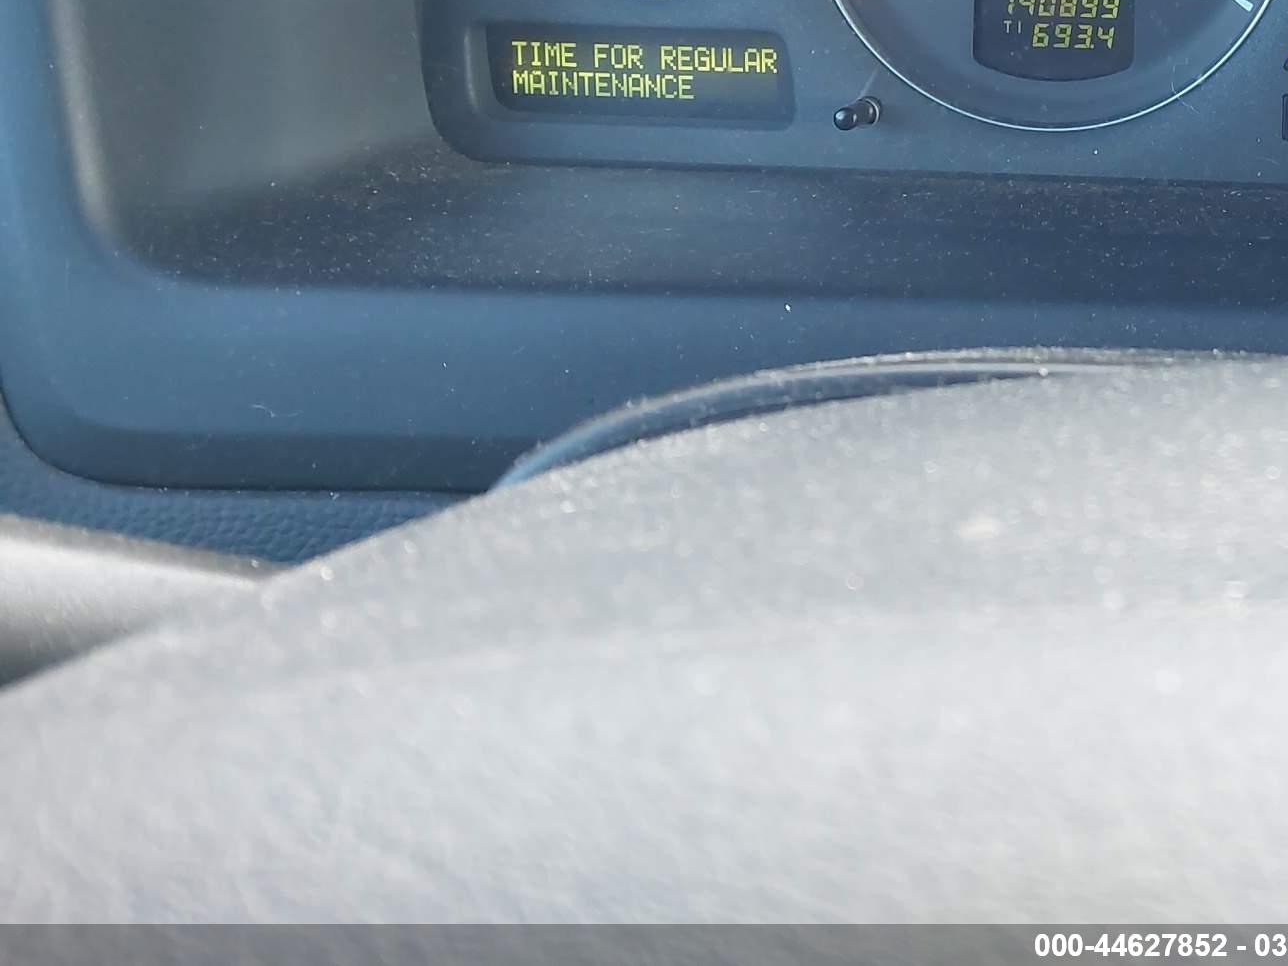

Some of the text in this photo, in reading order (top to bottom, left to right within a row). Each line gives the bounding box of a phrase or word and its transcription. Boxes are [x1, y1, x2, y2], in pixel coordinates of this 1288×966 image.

[1032, 23, 1115, 50] 693.4
[512, 41, 778, 73] TIME FOR REGULAR
[512, 70, 694, 100] MAINTENANCE
